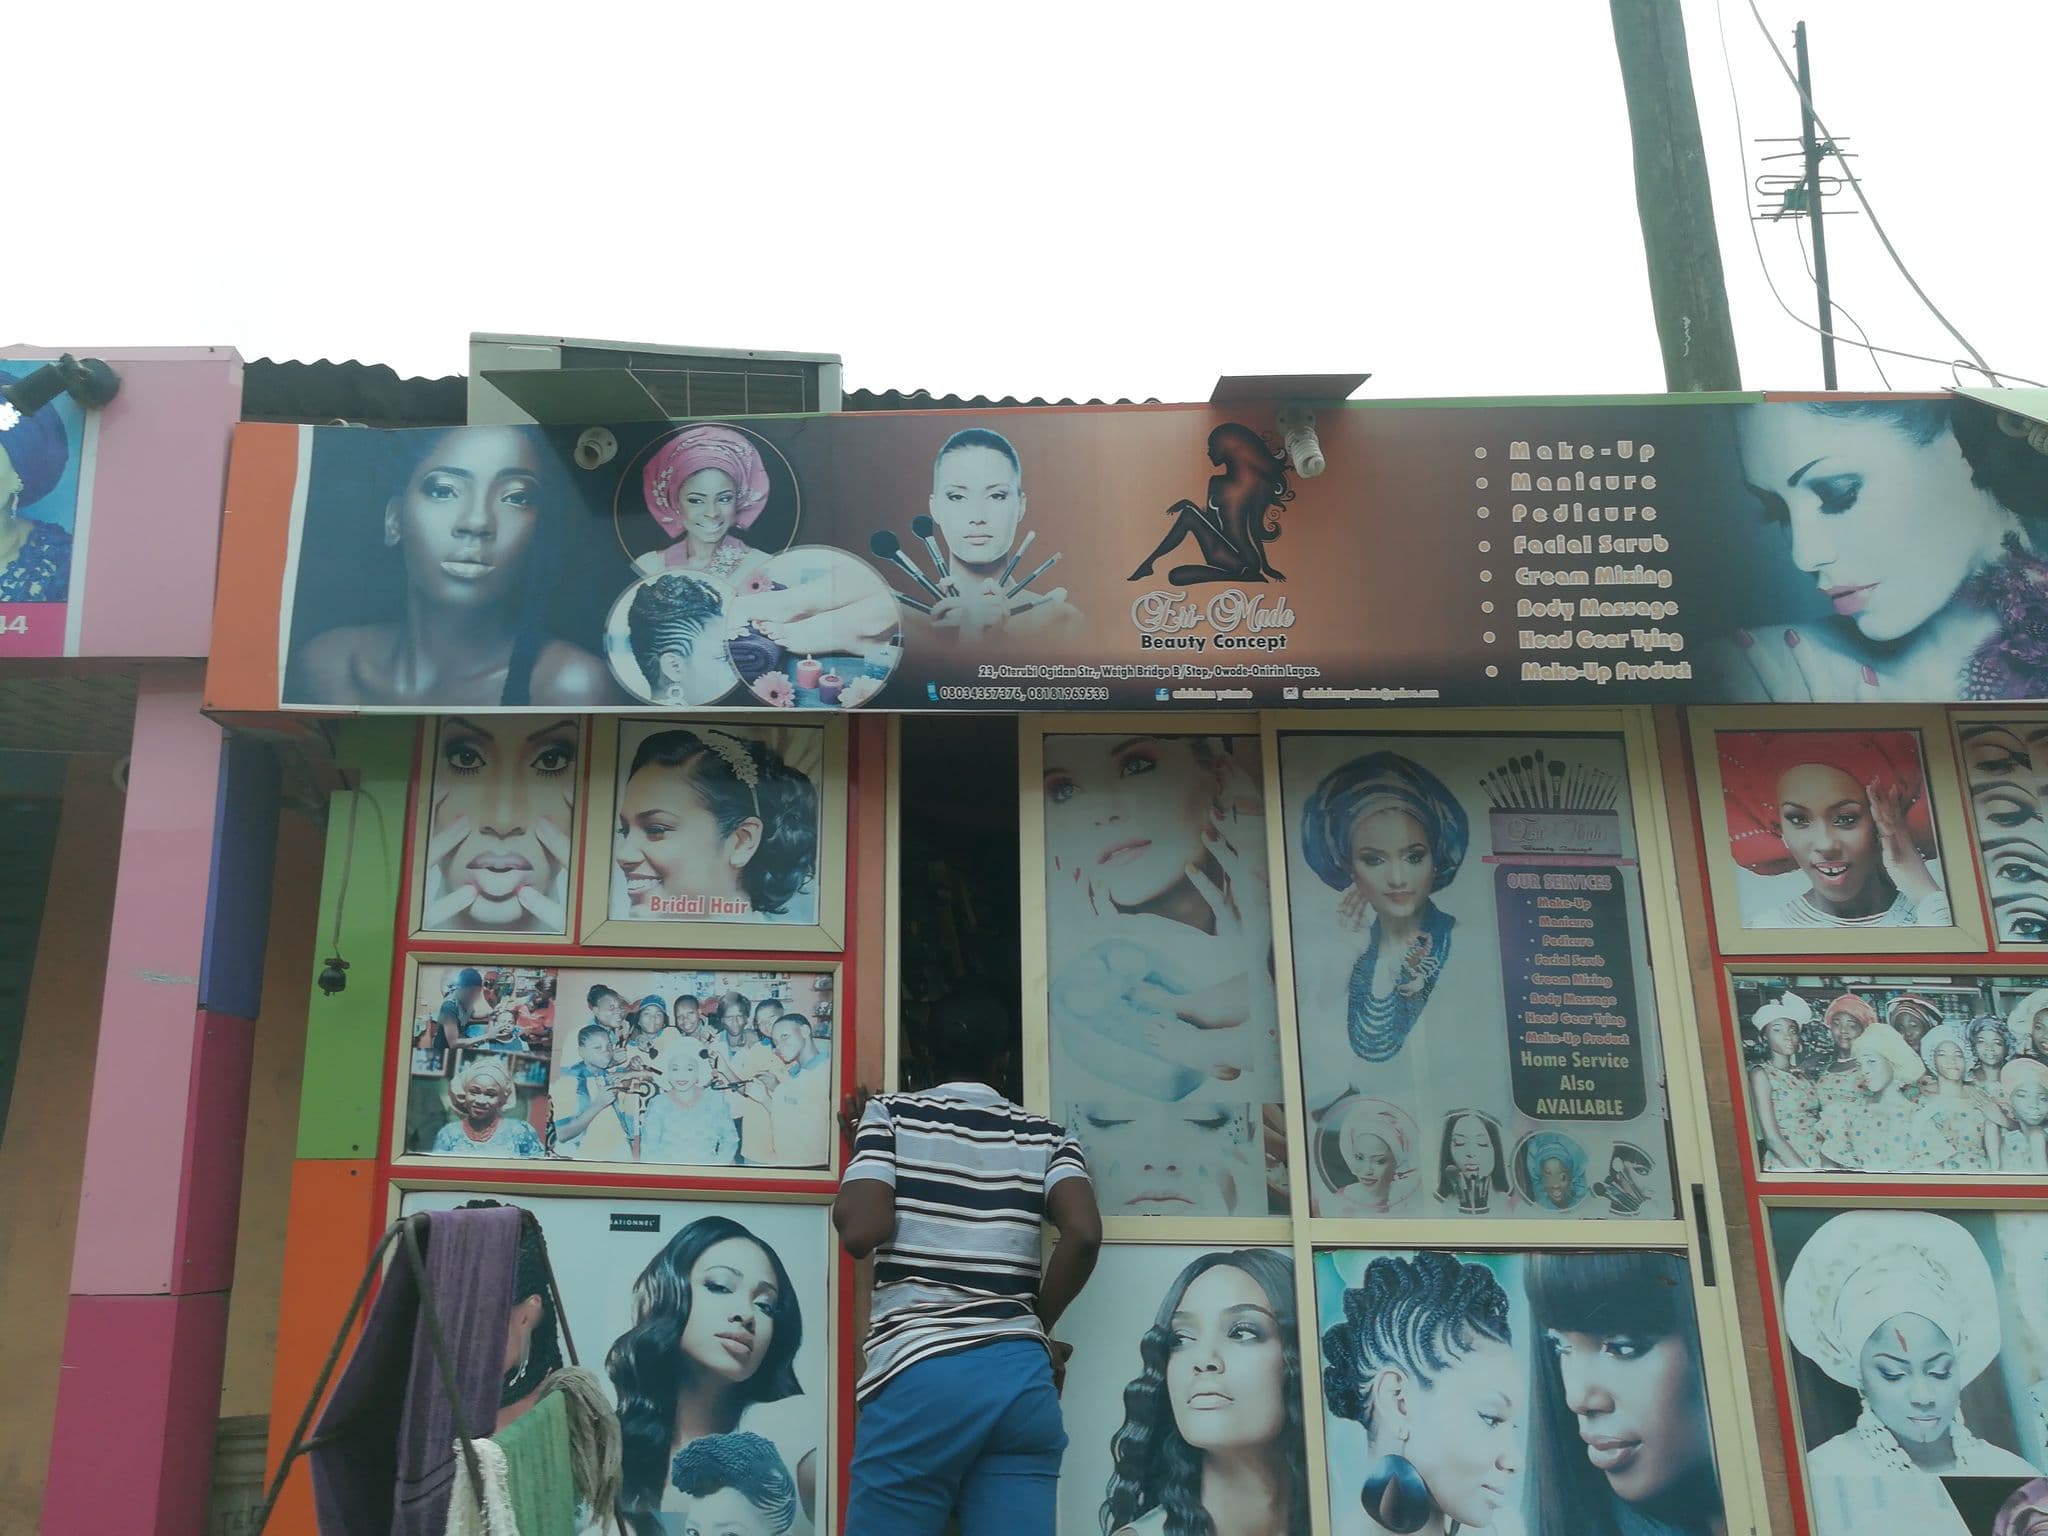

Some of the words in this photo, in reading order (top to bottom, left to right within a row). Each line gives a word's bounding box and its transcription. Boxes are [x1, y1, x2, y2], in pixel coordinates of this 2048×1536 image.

[1510, 471, 1657, 491] Manicure
[1512, 502, 1657, 522] Pedicure
[1513, 534, 1592, 554] Facial
[1598, 533, 1669, 554] Scrub
[1515, 566, 1590, 586] Cream
[1594, 564, 1673, 588] Mixing
[1517, 598, 1575, 621] Body
[1579, 598, 1679, 620] Massage
[1140, 633, 1207, 653] Beauty
[1213, 633, 1287, 653] Concept
[1518, 630, 1573, 649] Head
[1576, 629, 1629, 649] Gear
[1630, 627, 1684, 652] Tying
[1038, 665, 1076, 679] Ogidan
[1100, 665, 1135, 680] Weigh
[1135, 665, 1170, 680] Bridge
[1521, 661, 1612, 685] Make-Up
[1615, 661, 1693, 681] Product
[1506, 872, 1541, 889] OUR
[1543, 873, 1613, 891] SERVICES
[650, 895, 705, 914] Bridal
[709, 897, 749, 915] Hair
[1536, 896, 1592, 911] Make-Up
[1539, 915, 1594, 928] Manicure
[1542, 934, 1594, 947] Pedicure
[1535, 953, 1571, 966] Facial
[1571, 954, 1605, 967] Scrub
[1531, 972, 1571, 986] Cream
[1571, 973, 1613, 989] Mixing
[1529, 992, 1562, 1007] Body
[1563, 992, 1618, 1008] Massage
[1525, 1011, 1558, 1024] Head
[1560, 1012, 1593, 1025] Gear
[1593, 1012, 1627, 1028] Tying
[1525, 1030, 1581, 1047] Make-Up
[1582, 1032, 1630, 1046] Product
[1521, 1050, 1568, 1067] Home
[1571, 1051, 1630, 1069] Service
[1560, 1074, 1596, 1091] Also
[1536, 1098, 1624, 1116] AVAILABLE
